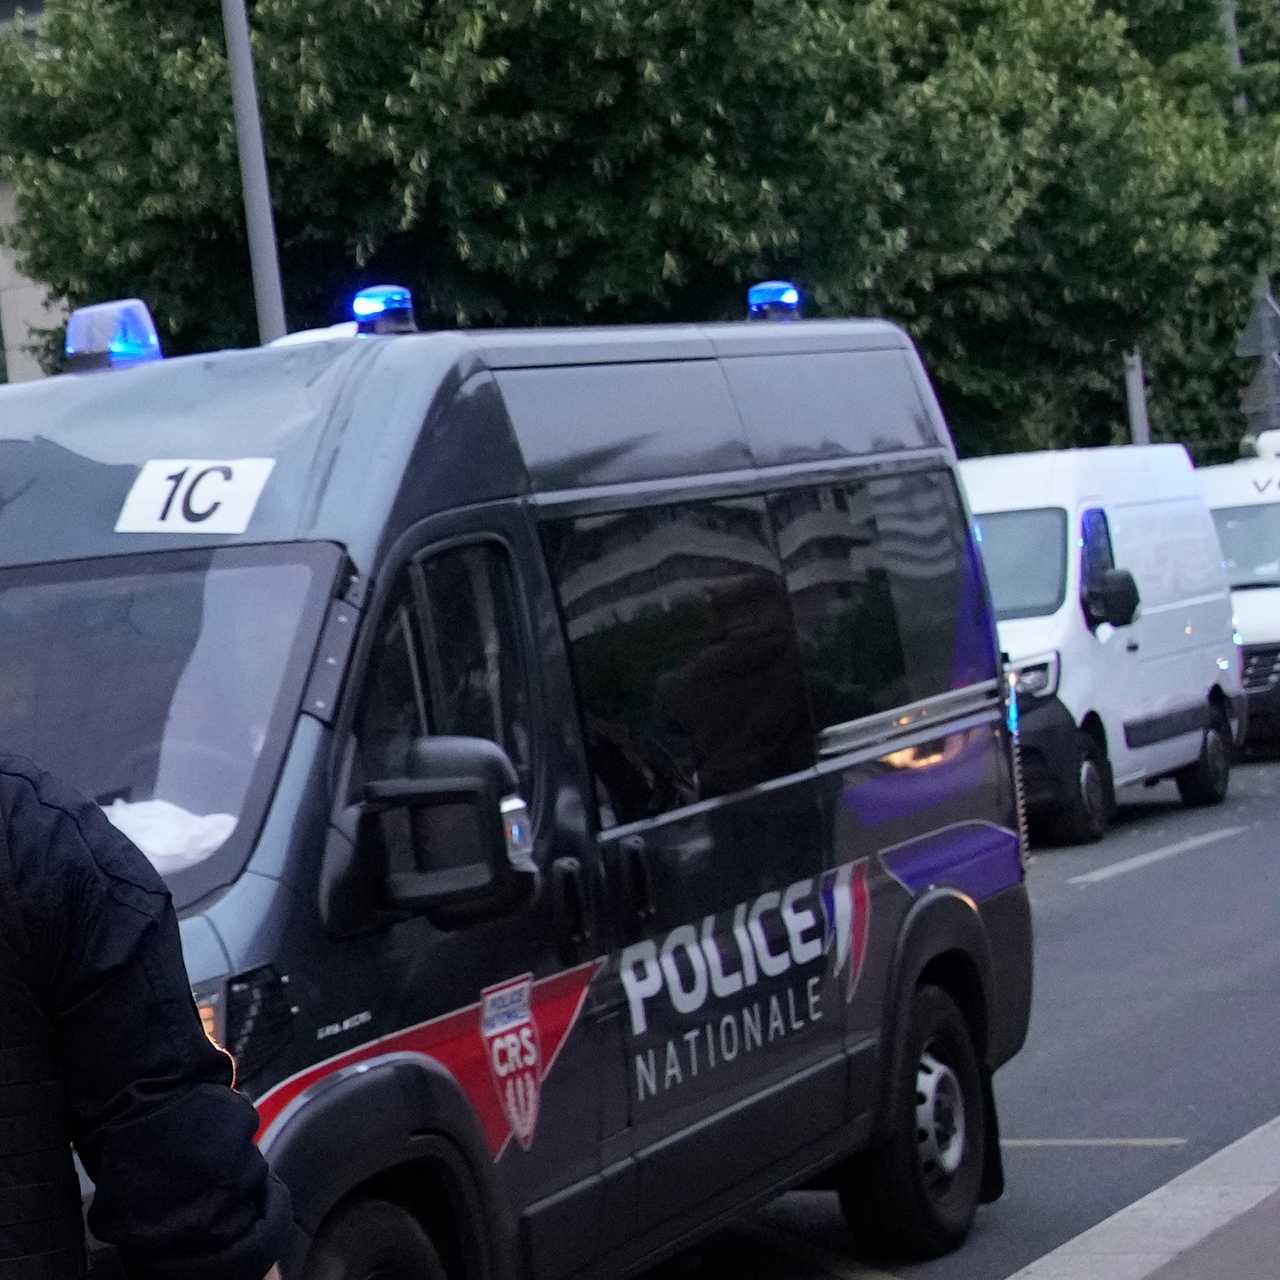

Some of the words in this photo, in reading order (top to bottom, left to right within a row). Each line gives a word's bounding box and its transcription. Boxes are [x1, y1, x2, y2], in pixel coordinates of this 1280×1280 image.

[158, 465, 233, 523] 1C
[620, 878, 824, 1036] POLICE
[492, 1027, 537, 1078] CRS
[635, 975, 824, 1101] NATIONALE
